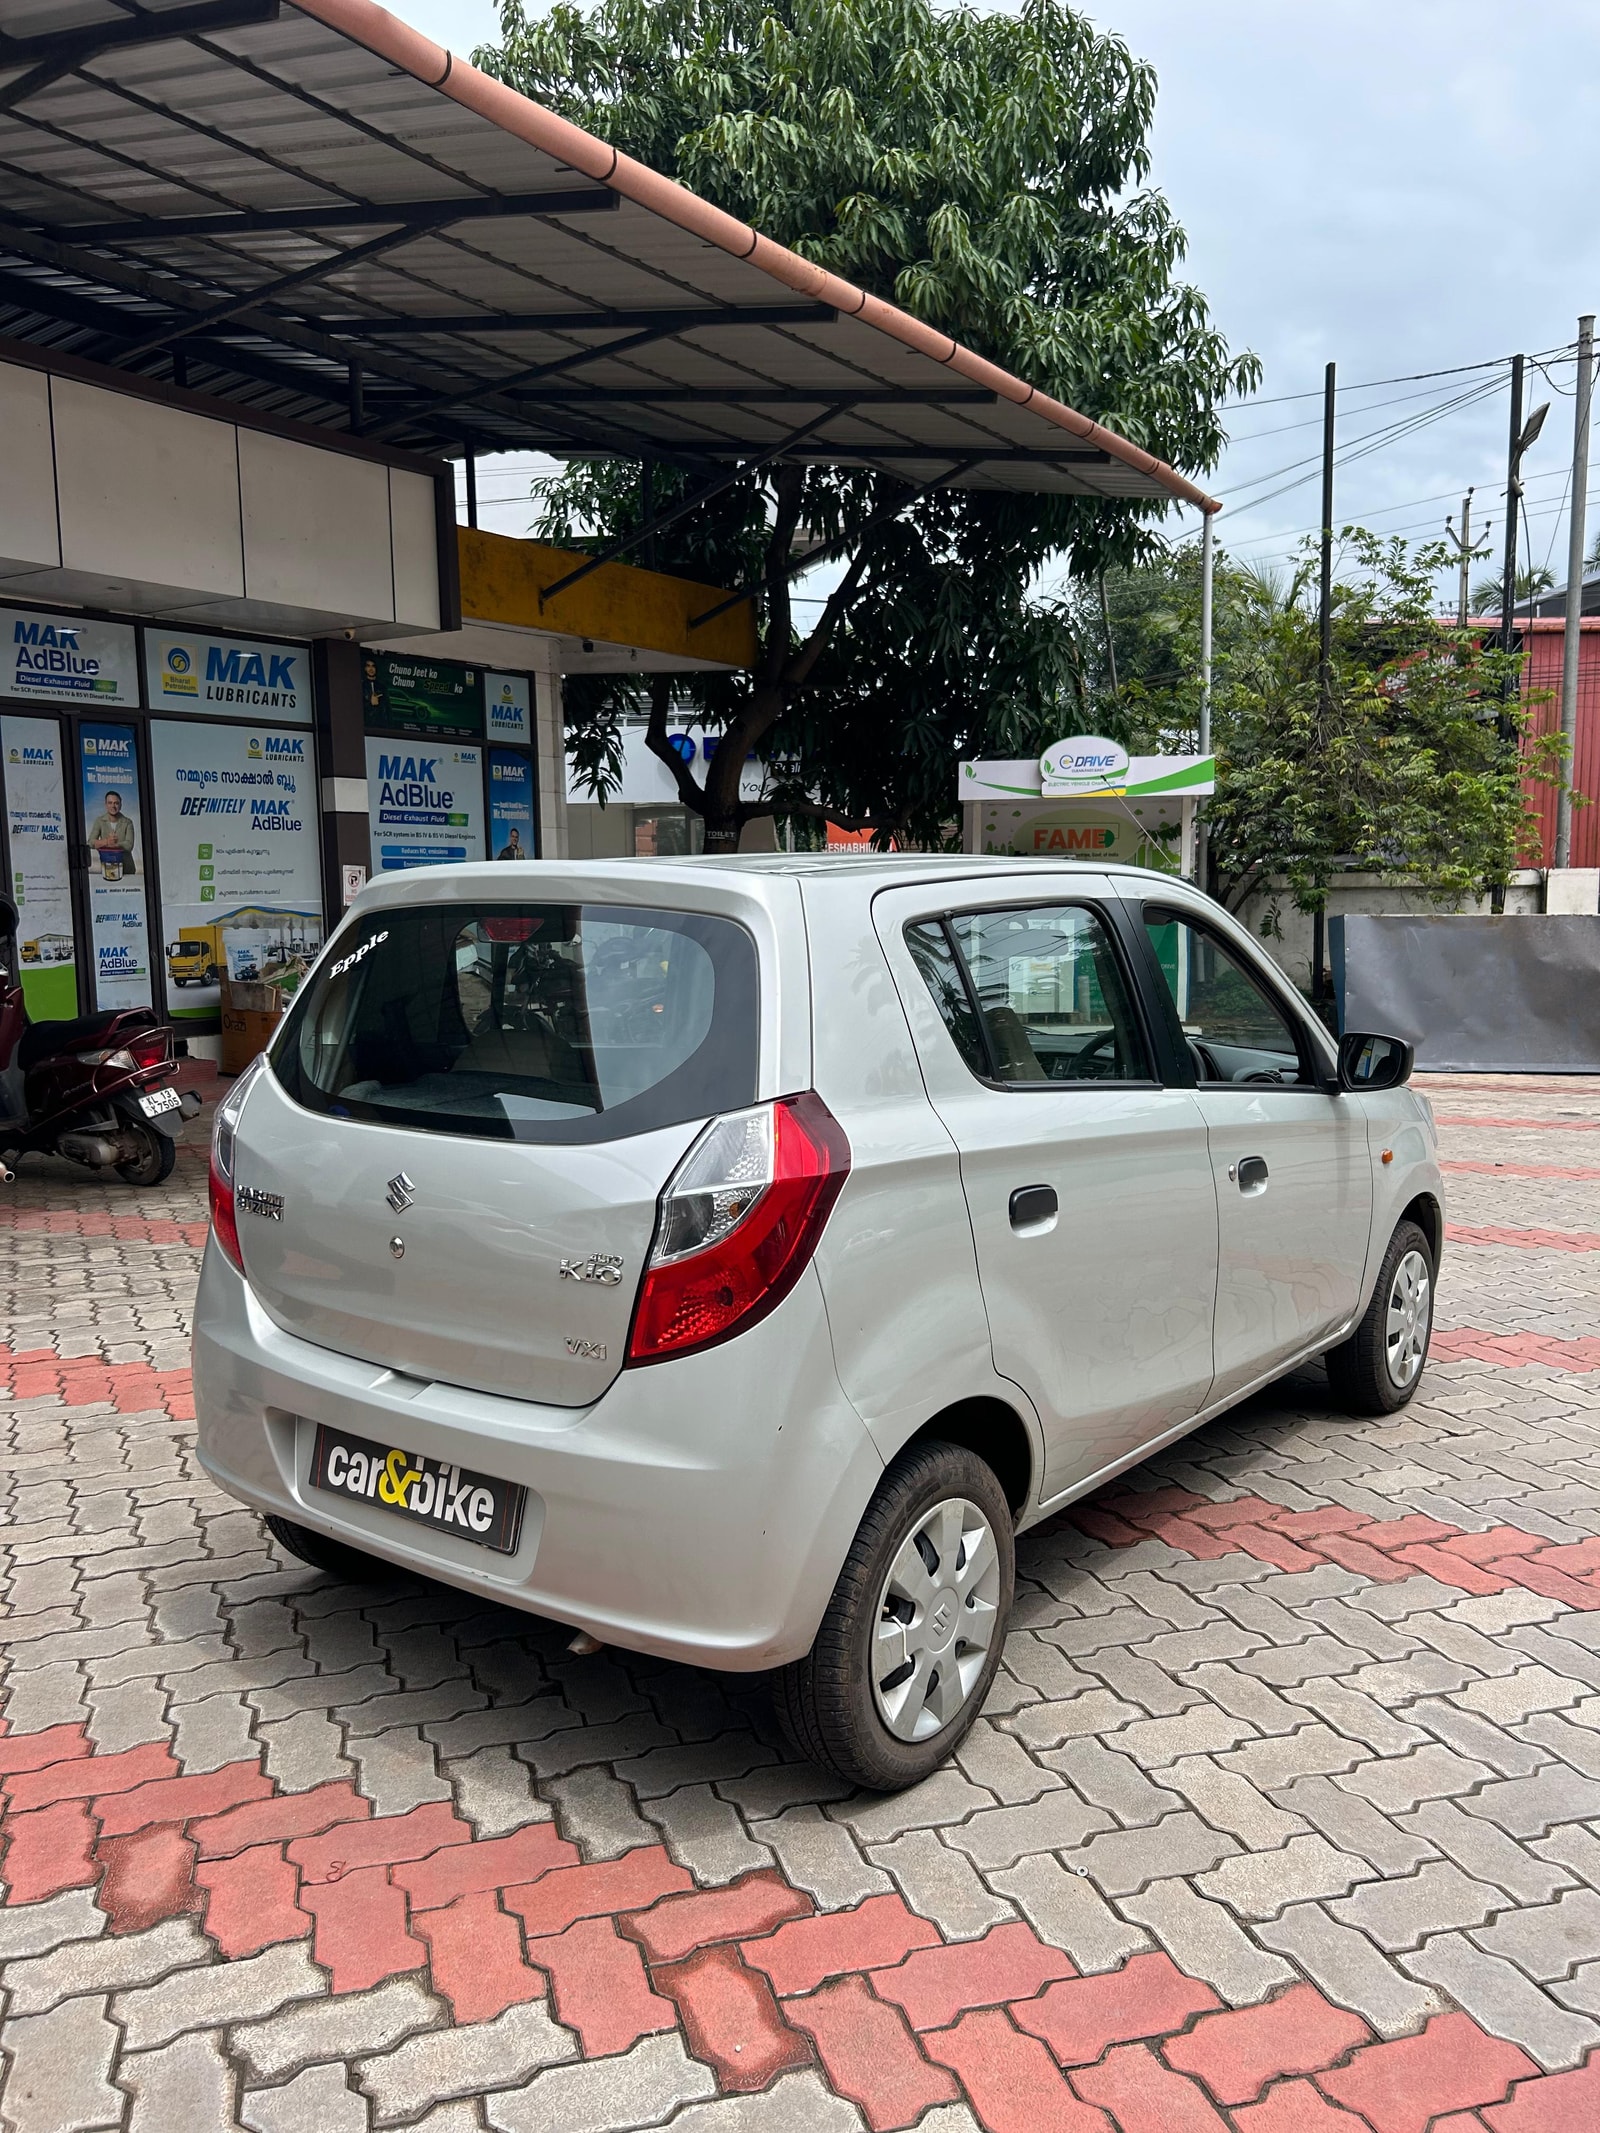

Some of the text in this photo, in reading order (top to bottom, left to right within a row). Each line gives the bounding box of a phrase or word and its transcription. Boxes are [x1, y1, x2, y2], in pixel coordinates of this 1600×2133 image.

[14, 621, 80, 650] MAK
[16, 646, 100, 675] AdBlue
[206, 646, 297, 690] MAK
[389, 663, 438, 679] Chuno Jeet ko
[20, 674, 42, 683] Diesel
[44, 677, 72, 687] Exhaust
[165, 682, 196, 691] Petroleum
[170, 676, 191, 684] Bharat
[392, 675, 464, 694] Chuno Speed ko
[105, 694, 125, 702] Engines
[206, 686, 297, 709] LUBRICANTS
[491, 704, 524, 722] MAK
[491, 720, 524, 731] LUBRICANTS
[98, 739, 130, 752] MAK
[265, 737, 305, 754] MAK
[22, 747, 54, 760] MAK
[265, 754, 305, 763] LUBRICANTS
[460, 752, 477, 760] MAK
[378, 754, 438, 783] MAK
[502, 765, 525, 777] MAK
[97, 773, 133, 785] Dependable
[176, 769, 218, 790] നമ്മുടെ
[741, 782, 771, 793] Your
[380, 782, 454, 809] AdBlue
[180, 797, 291, 817] DEFINITELY MAK
[251, 816, 303, 831] AdBlue
[383, 813, 402, 821] Diesel
[404, 814, 429, 823] Exhaust
[430, 815, 446, 823] Fluid
[41, 825, 60, 833] MAK
[393, 831, 410, 839] system
[706, 830, 736, 838] TOILET
[42, 833, 64, 841] AdBlue
[1034, 829, 1106, 850] FAME
[121, 913, 138, 921] MAK
[99, 946, 129, 959] MAK
[329, 931, 389, 979] Epple
[100, 958, 138, 969] AdBlue
[146, 1090, 172, 1106] KL 13
[157, 1097, 180, 1111] 7505
[237, 1197, 284, 1222] SUZUKI
[589, 1252, 623, 1267] ALTO
[327, 1445, 495, 1532] car&bike
